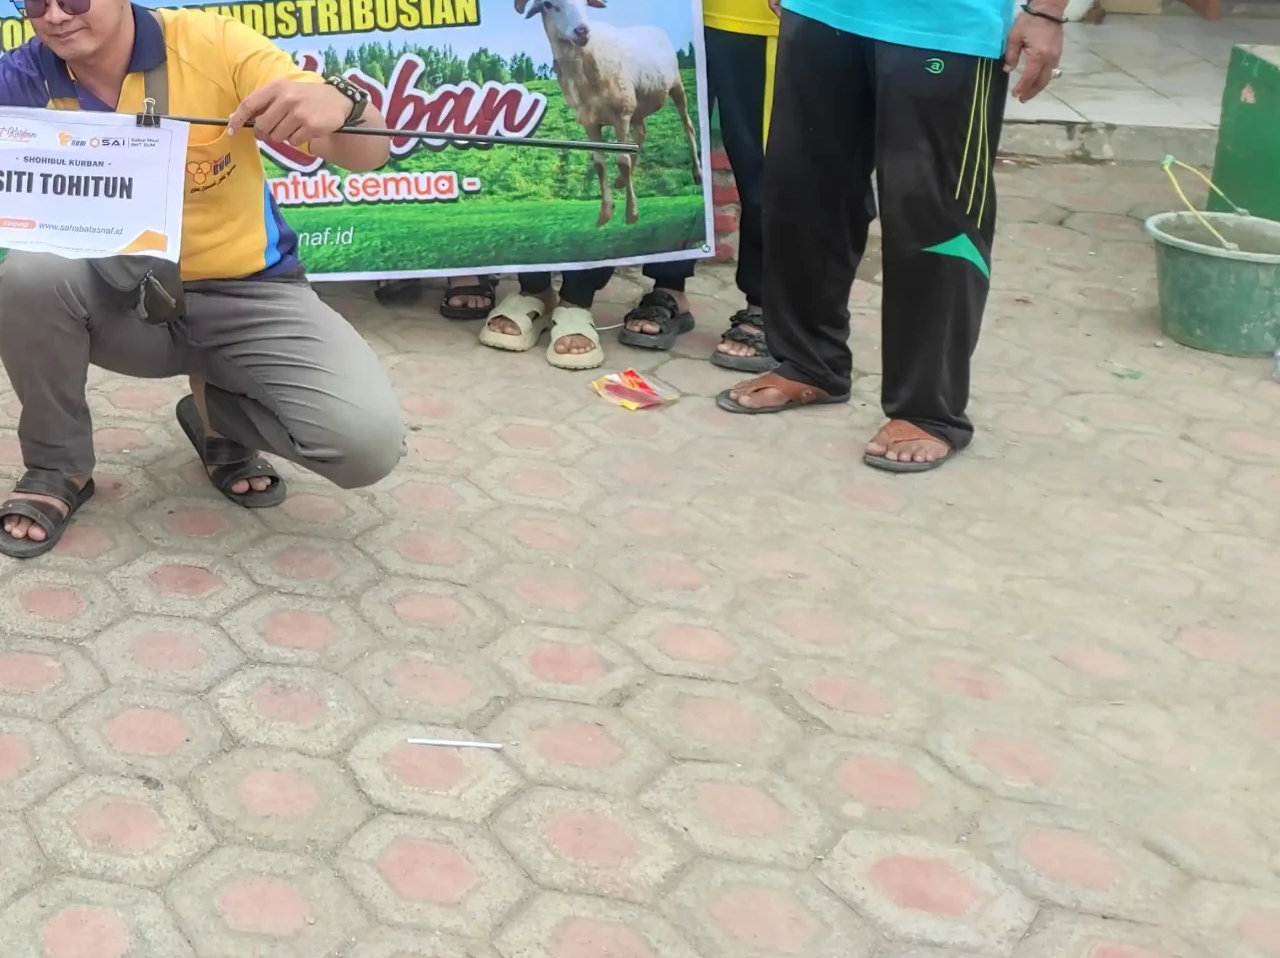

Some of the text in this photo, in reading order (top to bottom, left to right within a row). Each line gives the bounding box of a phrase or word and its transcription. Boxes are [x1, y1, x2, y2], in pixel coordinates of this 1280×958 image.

[23, 155, 105, 168] SHOHIBUL KURBAN
[39, 172, 134, 200] TOHITUN
[272, 173, 338, 200] ntuk
[348, 173, 456, 198] semua
[39, 222, 124, 236] www.sahabatasnaf.id
[298, 226, 354, 247] naf.id
